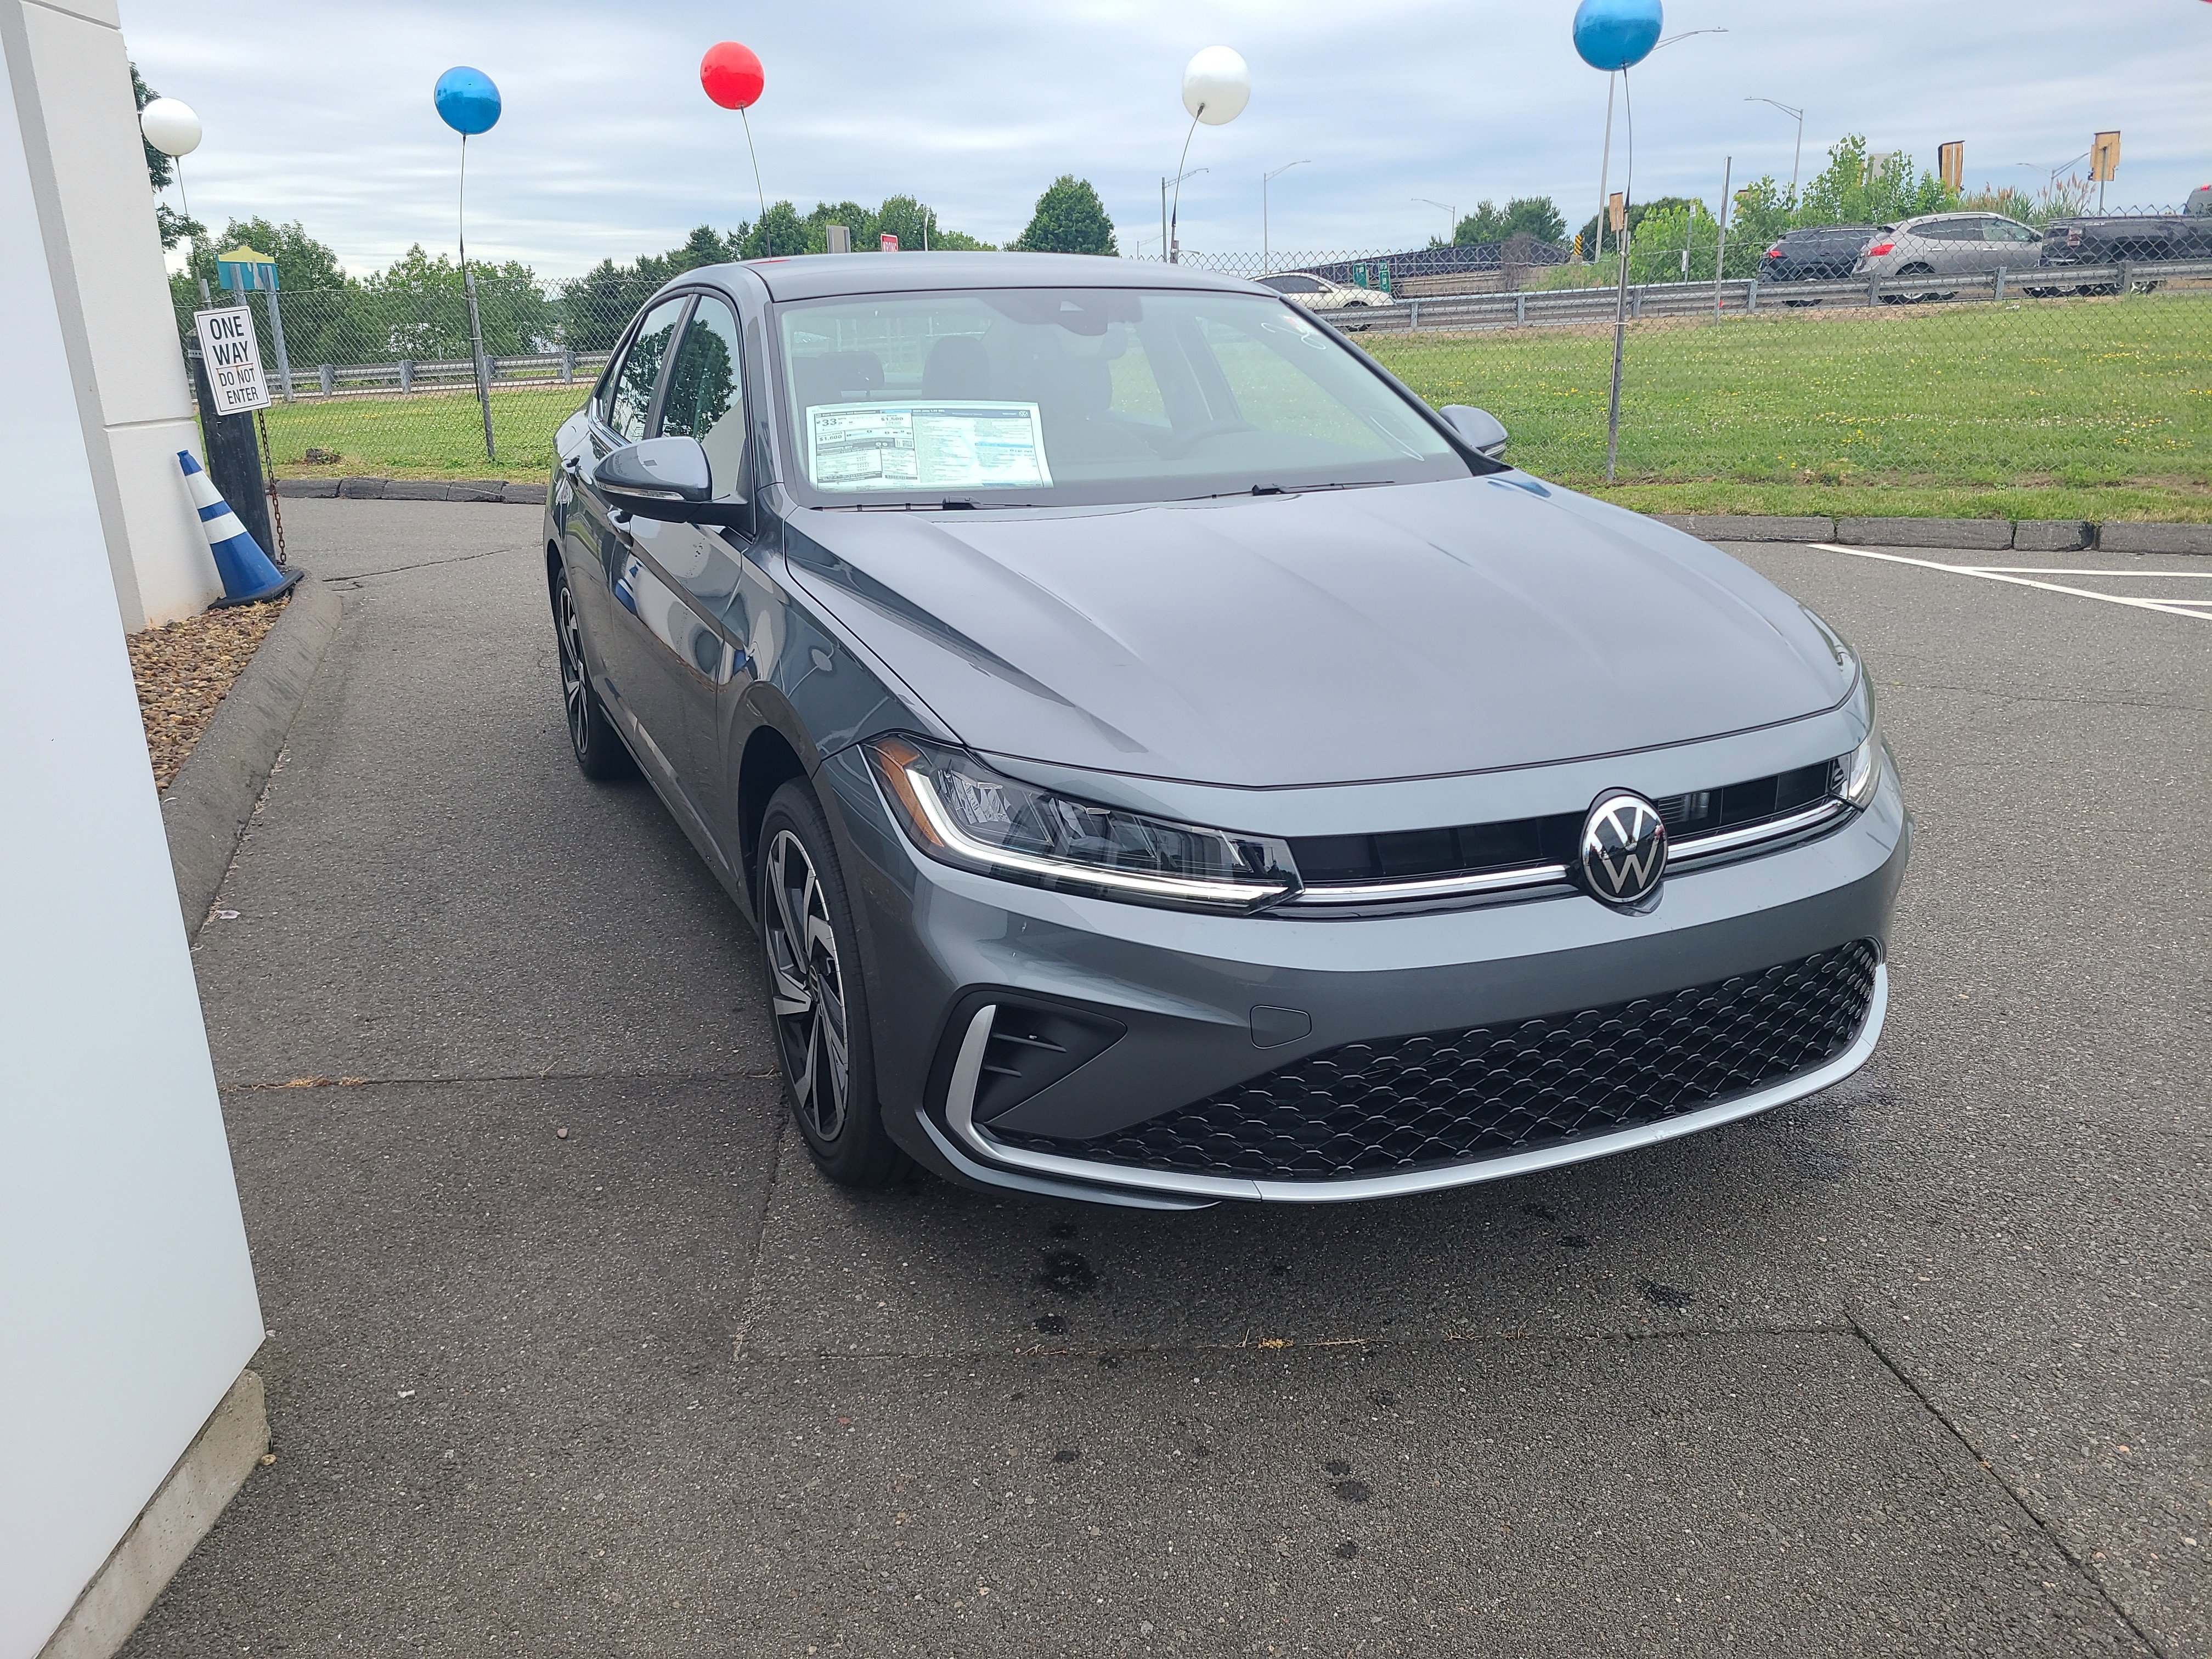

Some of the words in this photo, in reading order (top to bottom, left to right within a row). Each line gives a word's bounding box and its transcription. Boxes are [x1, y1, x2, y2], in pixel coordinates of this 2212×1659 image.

[210, 315, 244, 340] ONE
[212, 341, 248, 366] WAY
[219, 371, 235, 387] DO
[237, 368, 256, 384] NOT
[226, 386, 259, 405] ENTER
[822, 418, 837, 426] 33
[1585, 801, 1662, 895] VW
